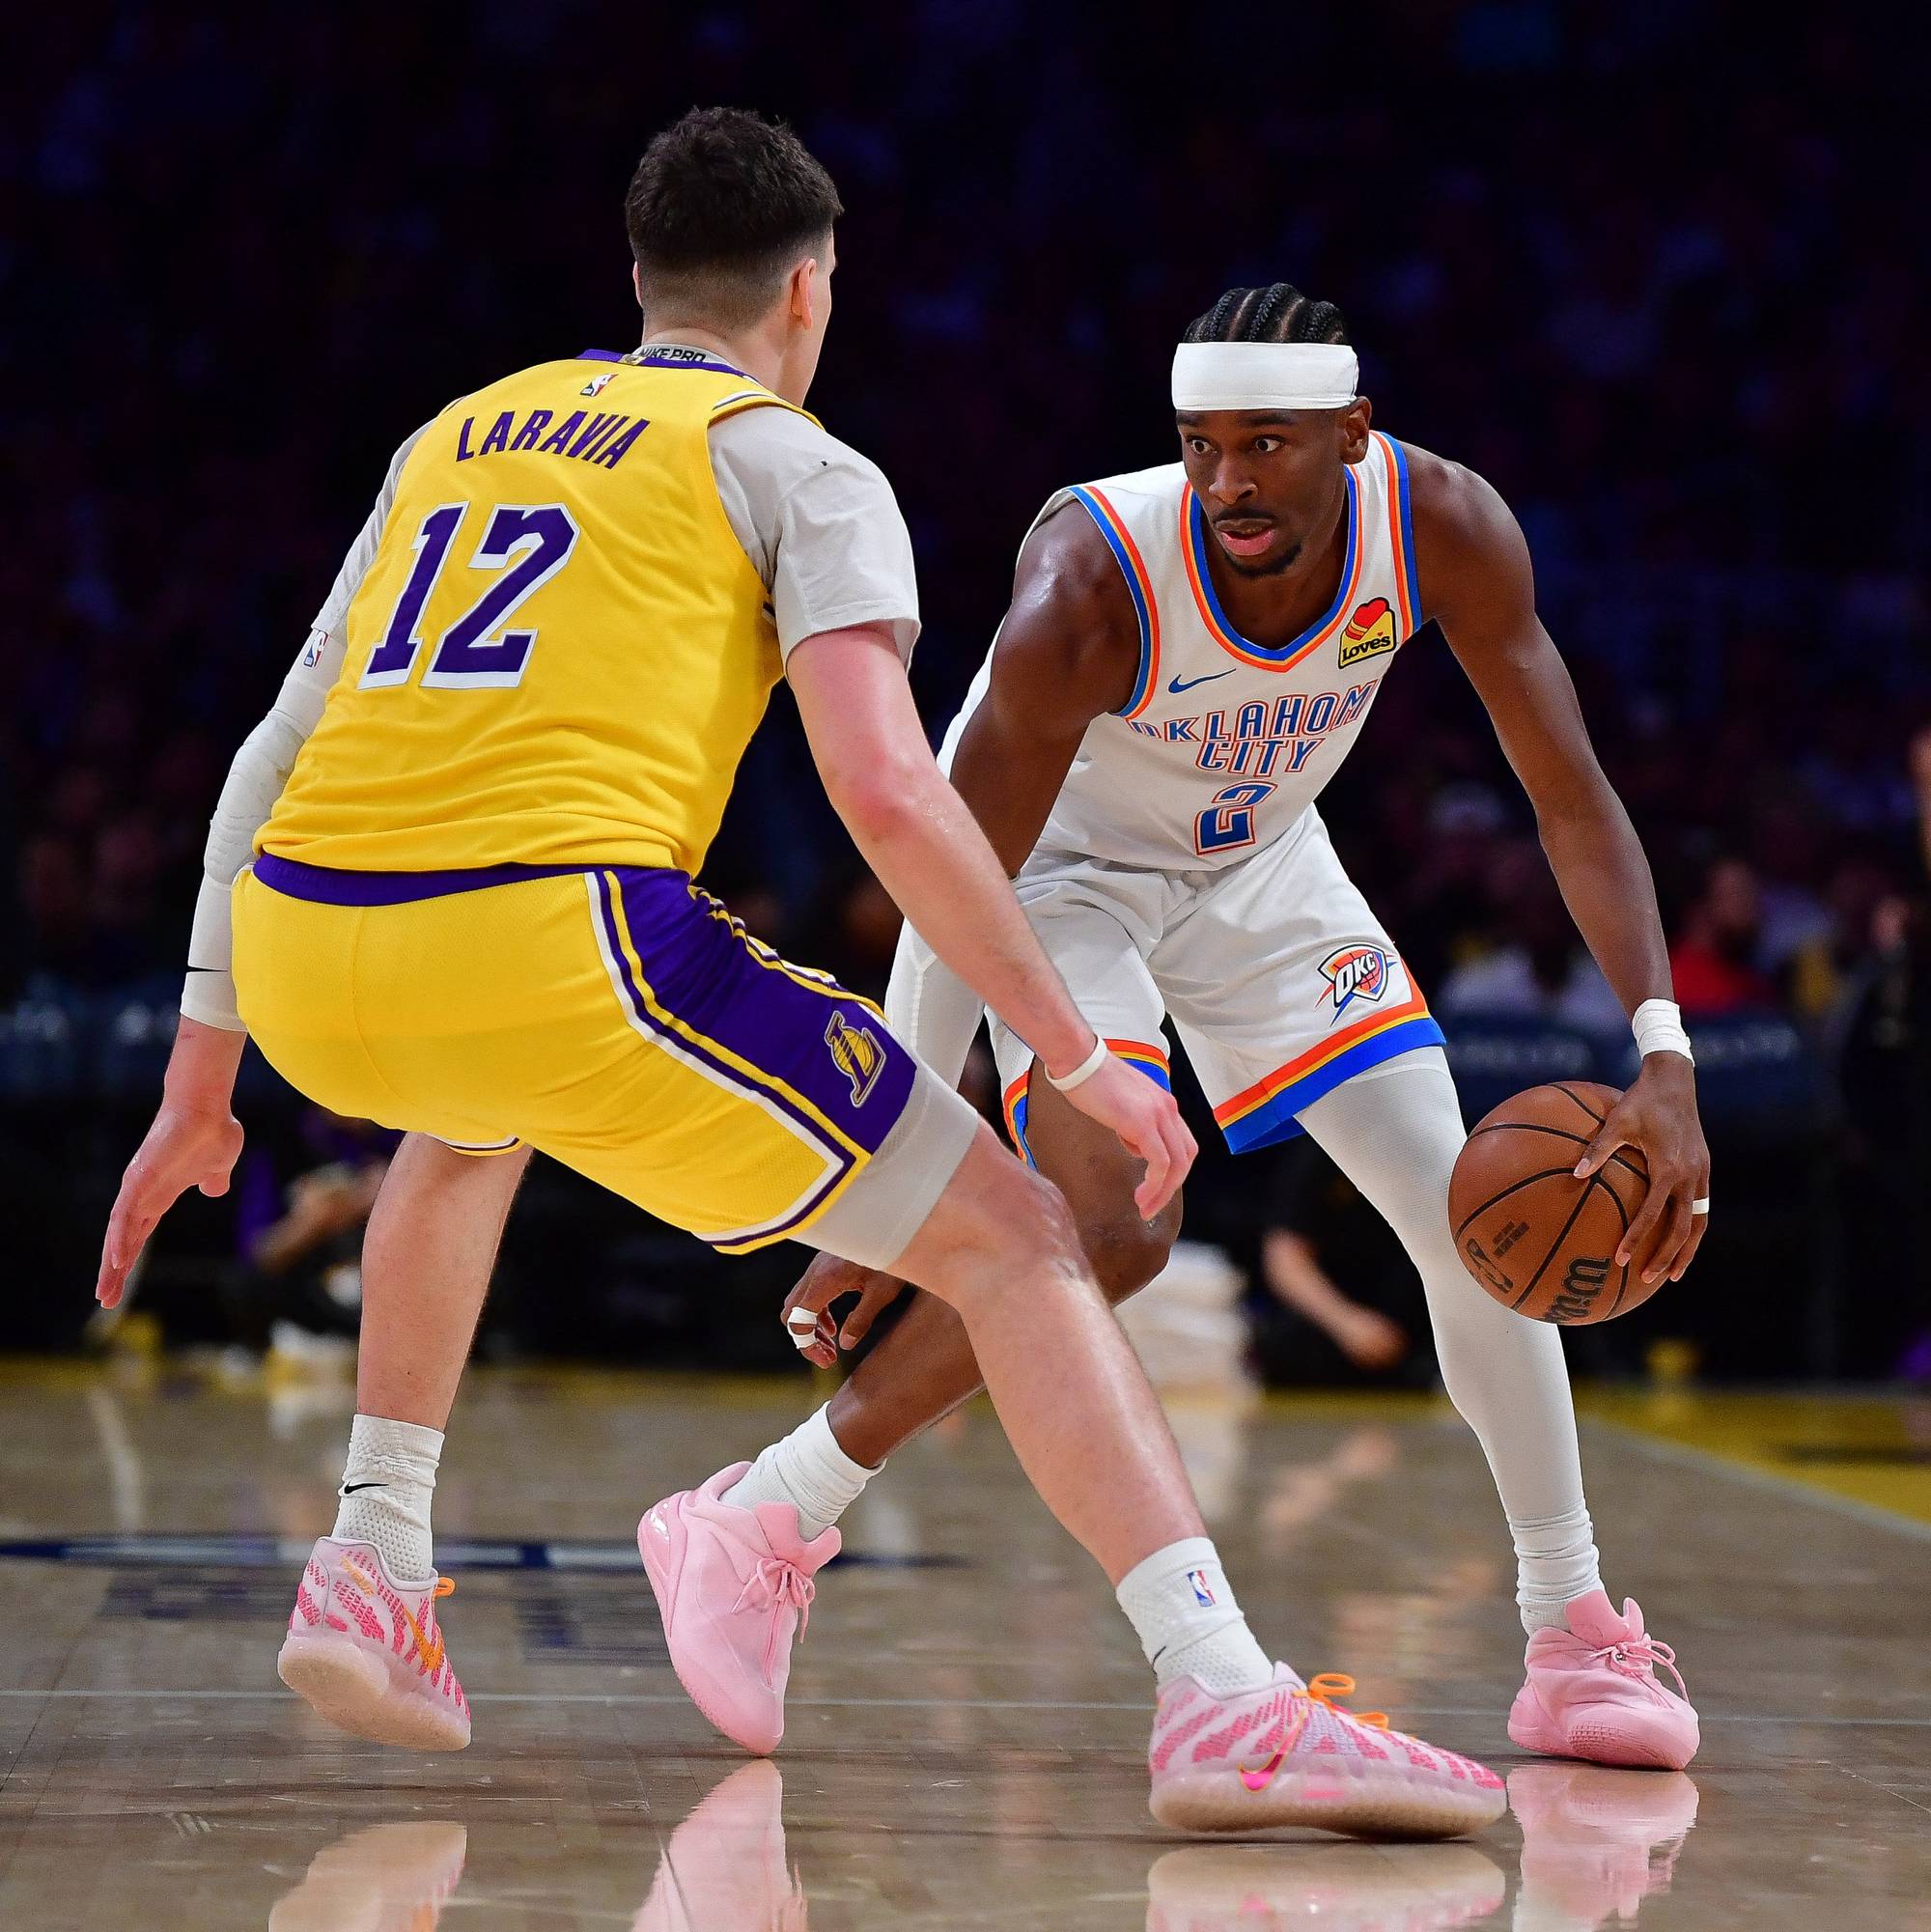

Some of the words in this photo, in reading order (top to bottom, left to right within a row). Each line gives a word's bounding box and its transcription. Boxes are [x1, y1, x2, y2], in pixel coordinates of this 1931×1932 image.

[670, 349, 706, 362] PRO
[456, 409, 650, 469] LARAVIA
[357, 500, 580, 689] 12
[1195, 738, 1326, 777] CITY
[1193, 780, 1277, 855] 2
[1334, 952, 1377, 1005] OKC
